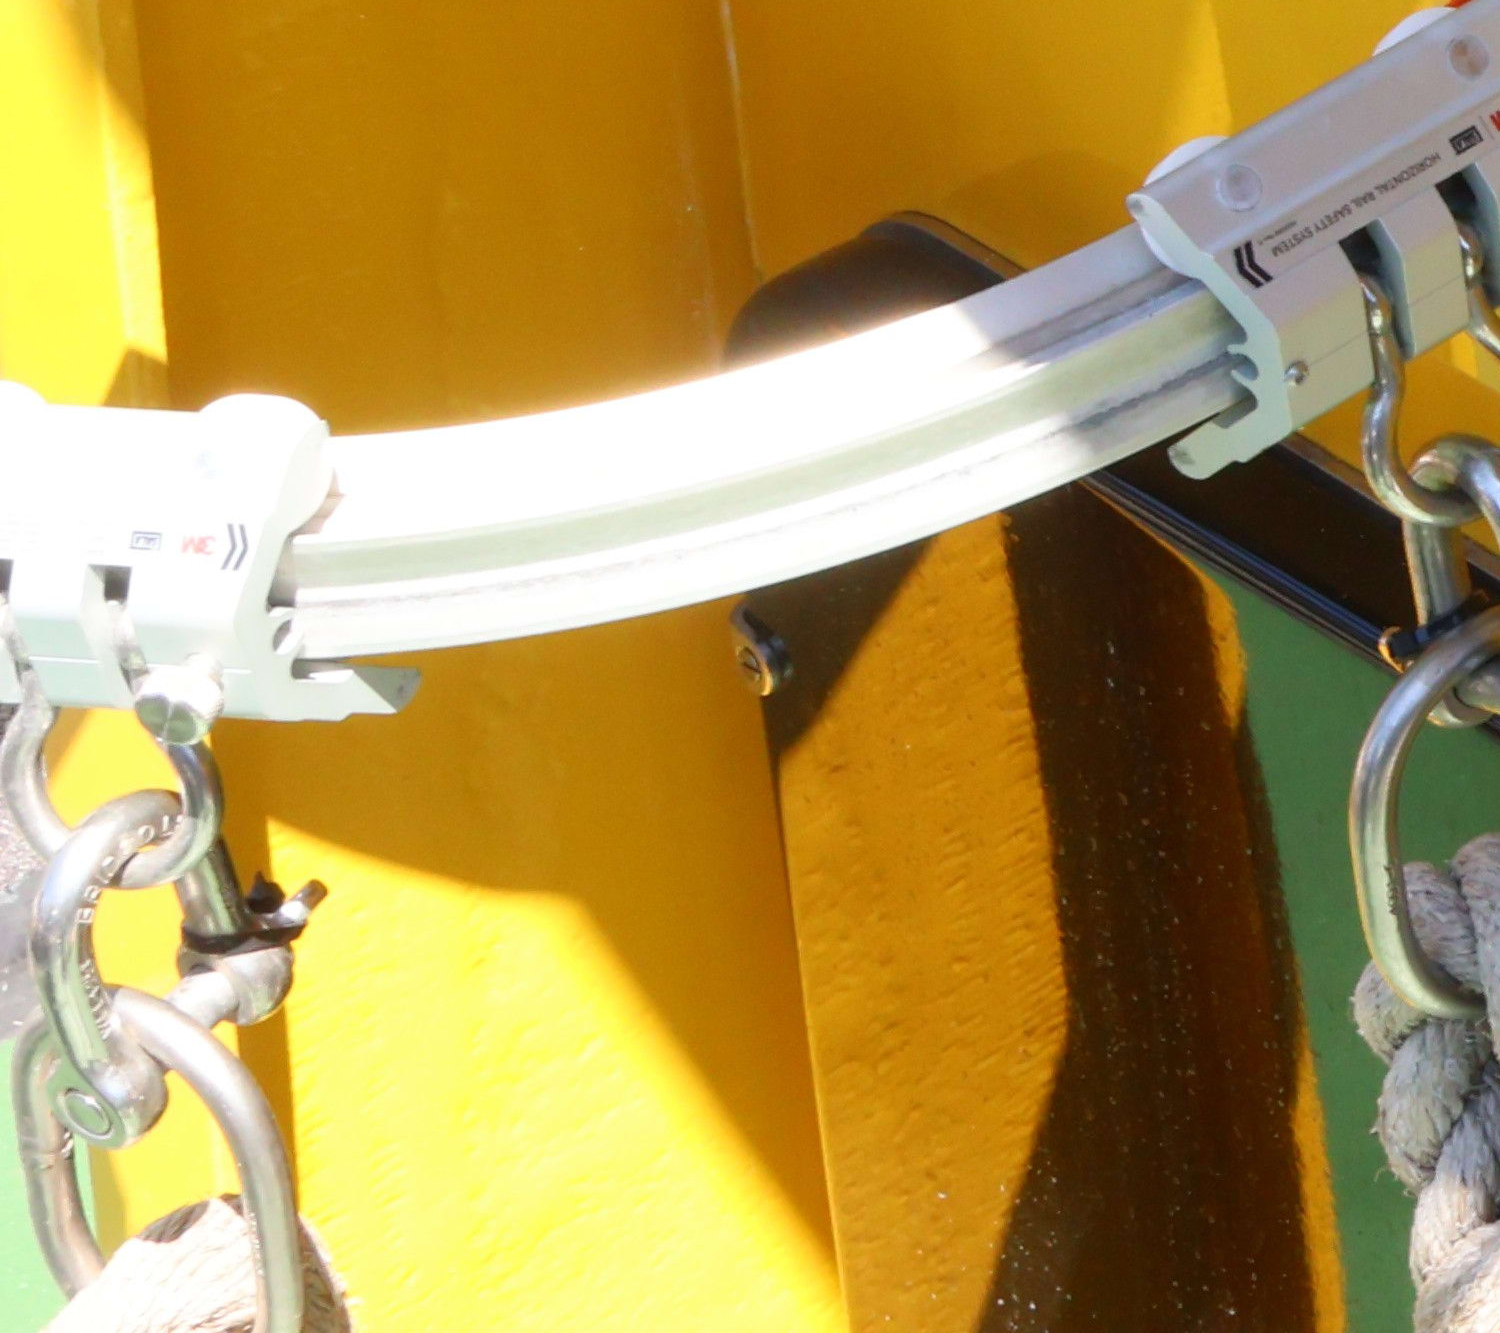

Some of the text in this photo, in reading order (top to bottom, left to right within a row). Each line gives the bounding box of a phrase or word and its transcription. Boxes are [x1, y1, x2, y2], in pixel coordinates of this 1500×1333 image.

[1374, 153, 1441, 194] HORIZONTAL
[1350, 190, 1377, 209] RAIL
[1313, 204, 1352, 232] SAFETY
[1271, 226, 1312, 257] SYSTEM
